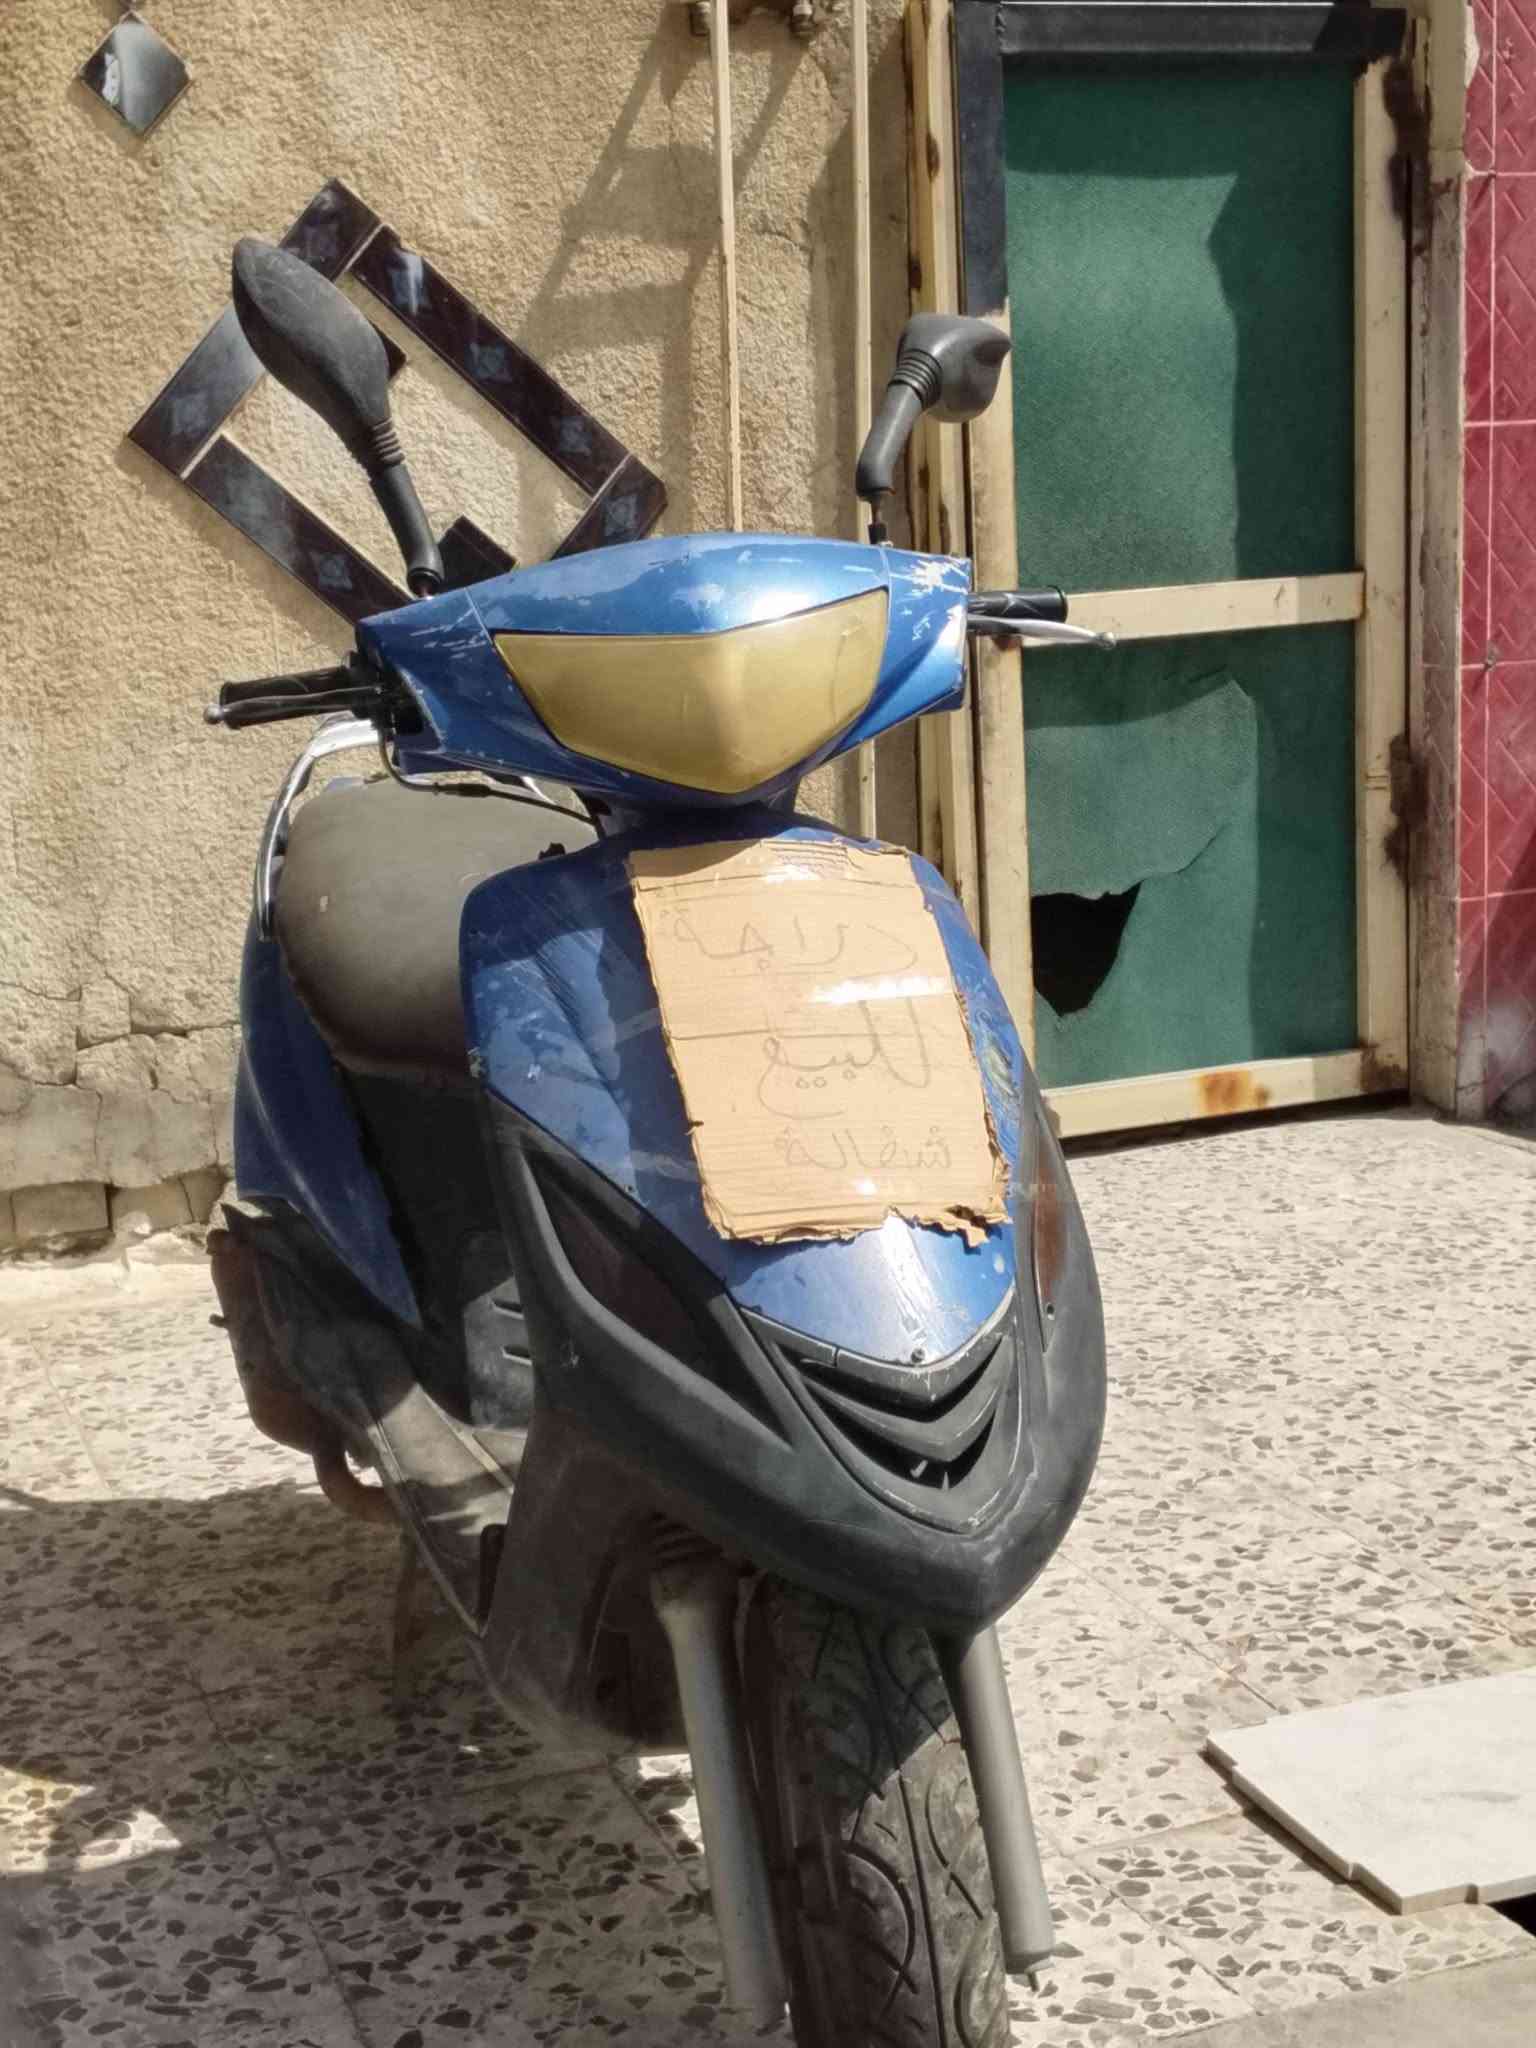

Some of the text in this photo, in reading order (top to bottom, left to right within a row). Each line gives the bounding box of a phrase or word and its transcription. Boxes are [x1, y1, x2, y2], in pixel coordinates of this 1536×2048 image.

[660, 906, 918, 980] دراجة
[757, 996, 932, 1120] للبيع
[775, 1125, 952, 1170] شغالة
